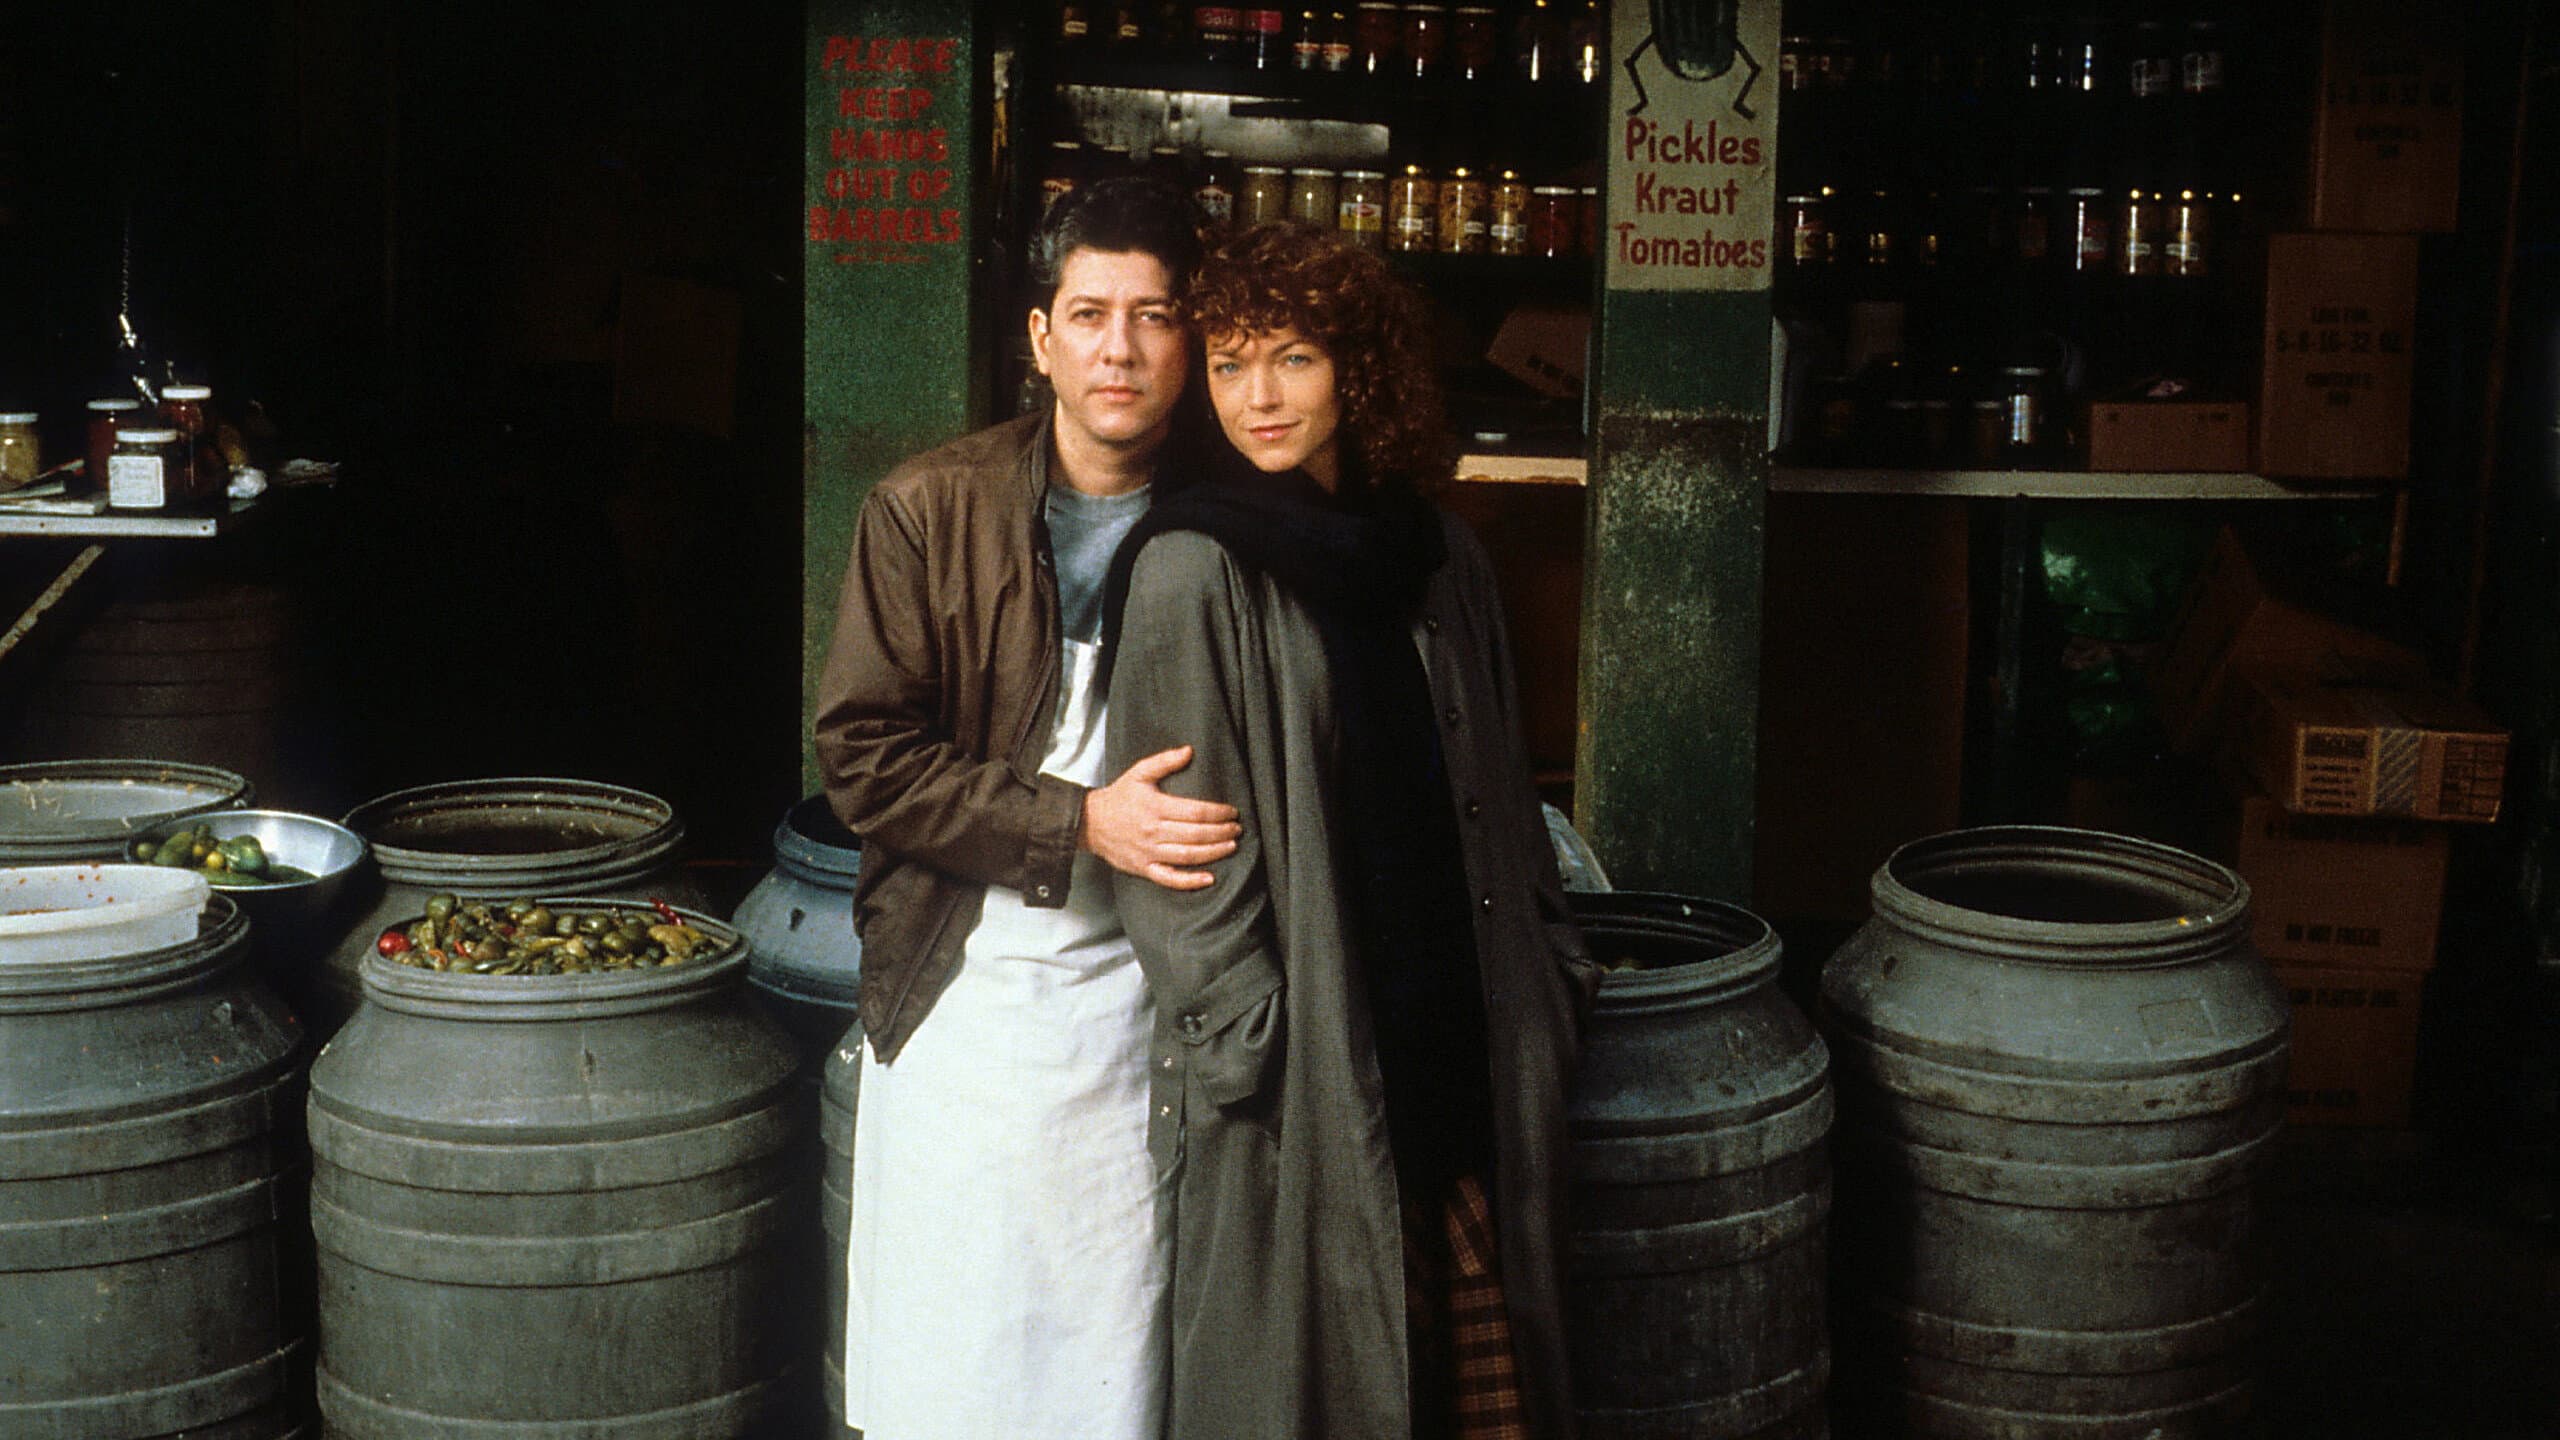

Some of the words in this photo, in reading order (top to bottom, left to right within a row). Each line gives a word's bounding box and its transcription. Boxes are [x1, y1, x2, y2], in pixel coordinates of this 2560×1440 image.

[822, 35, 958, 72] PLEASE
[840, 87, 934, 119] KEEP
[831, 127, 948, 161] HANDS
[1626, 116, 1761, 165] Pickles
[825, 168, 899, 200] OUT
[907, 169, 953, 200] OF
[1635, 171, 1740, 215] Kraut
[809, 206, 962, 242] BARRELS
[1613, 221, 1766, 268] Tomatoes
